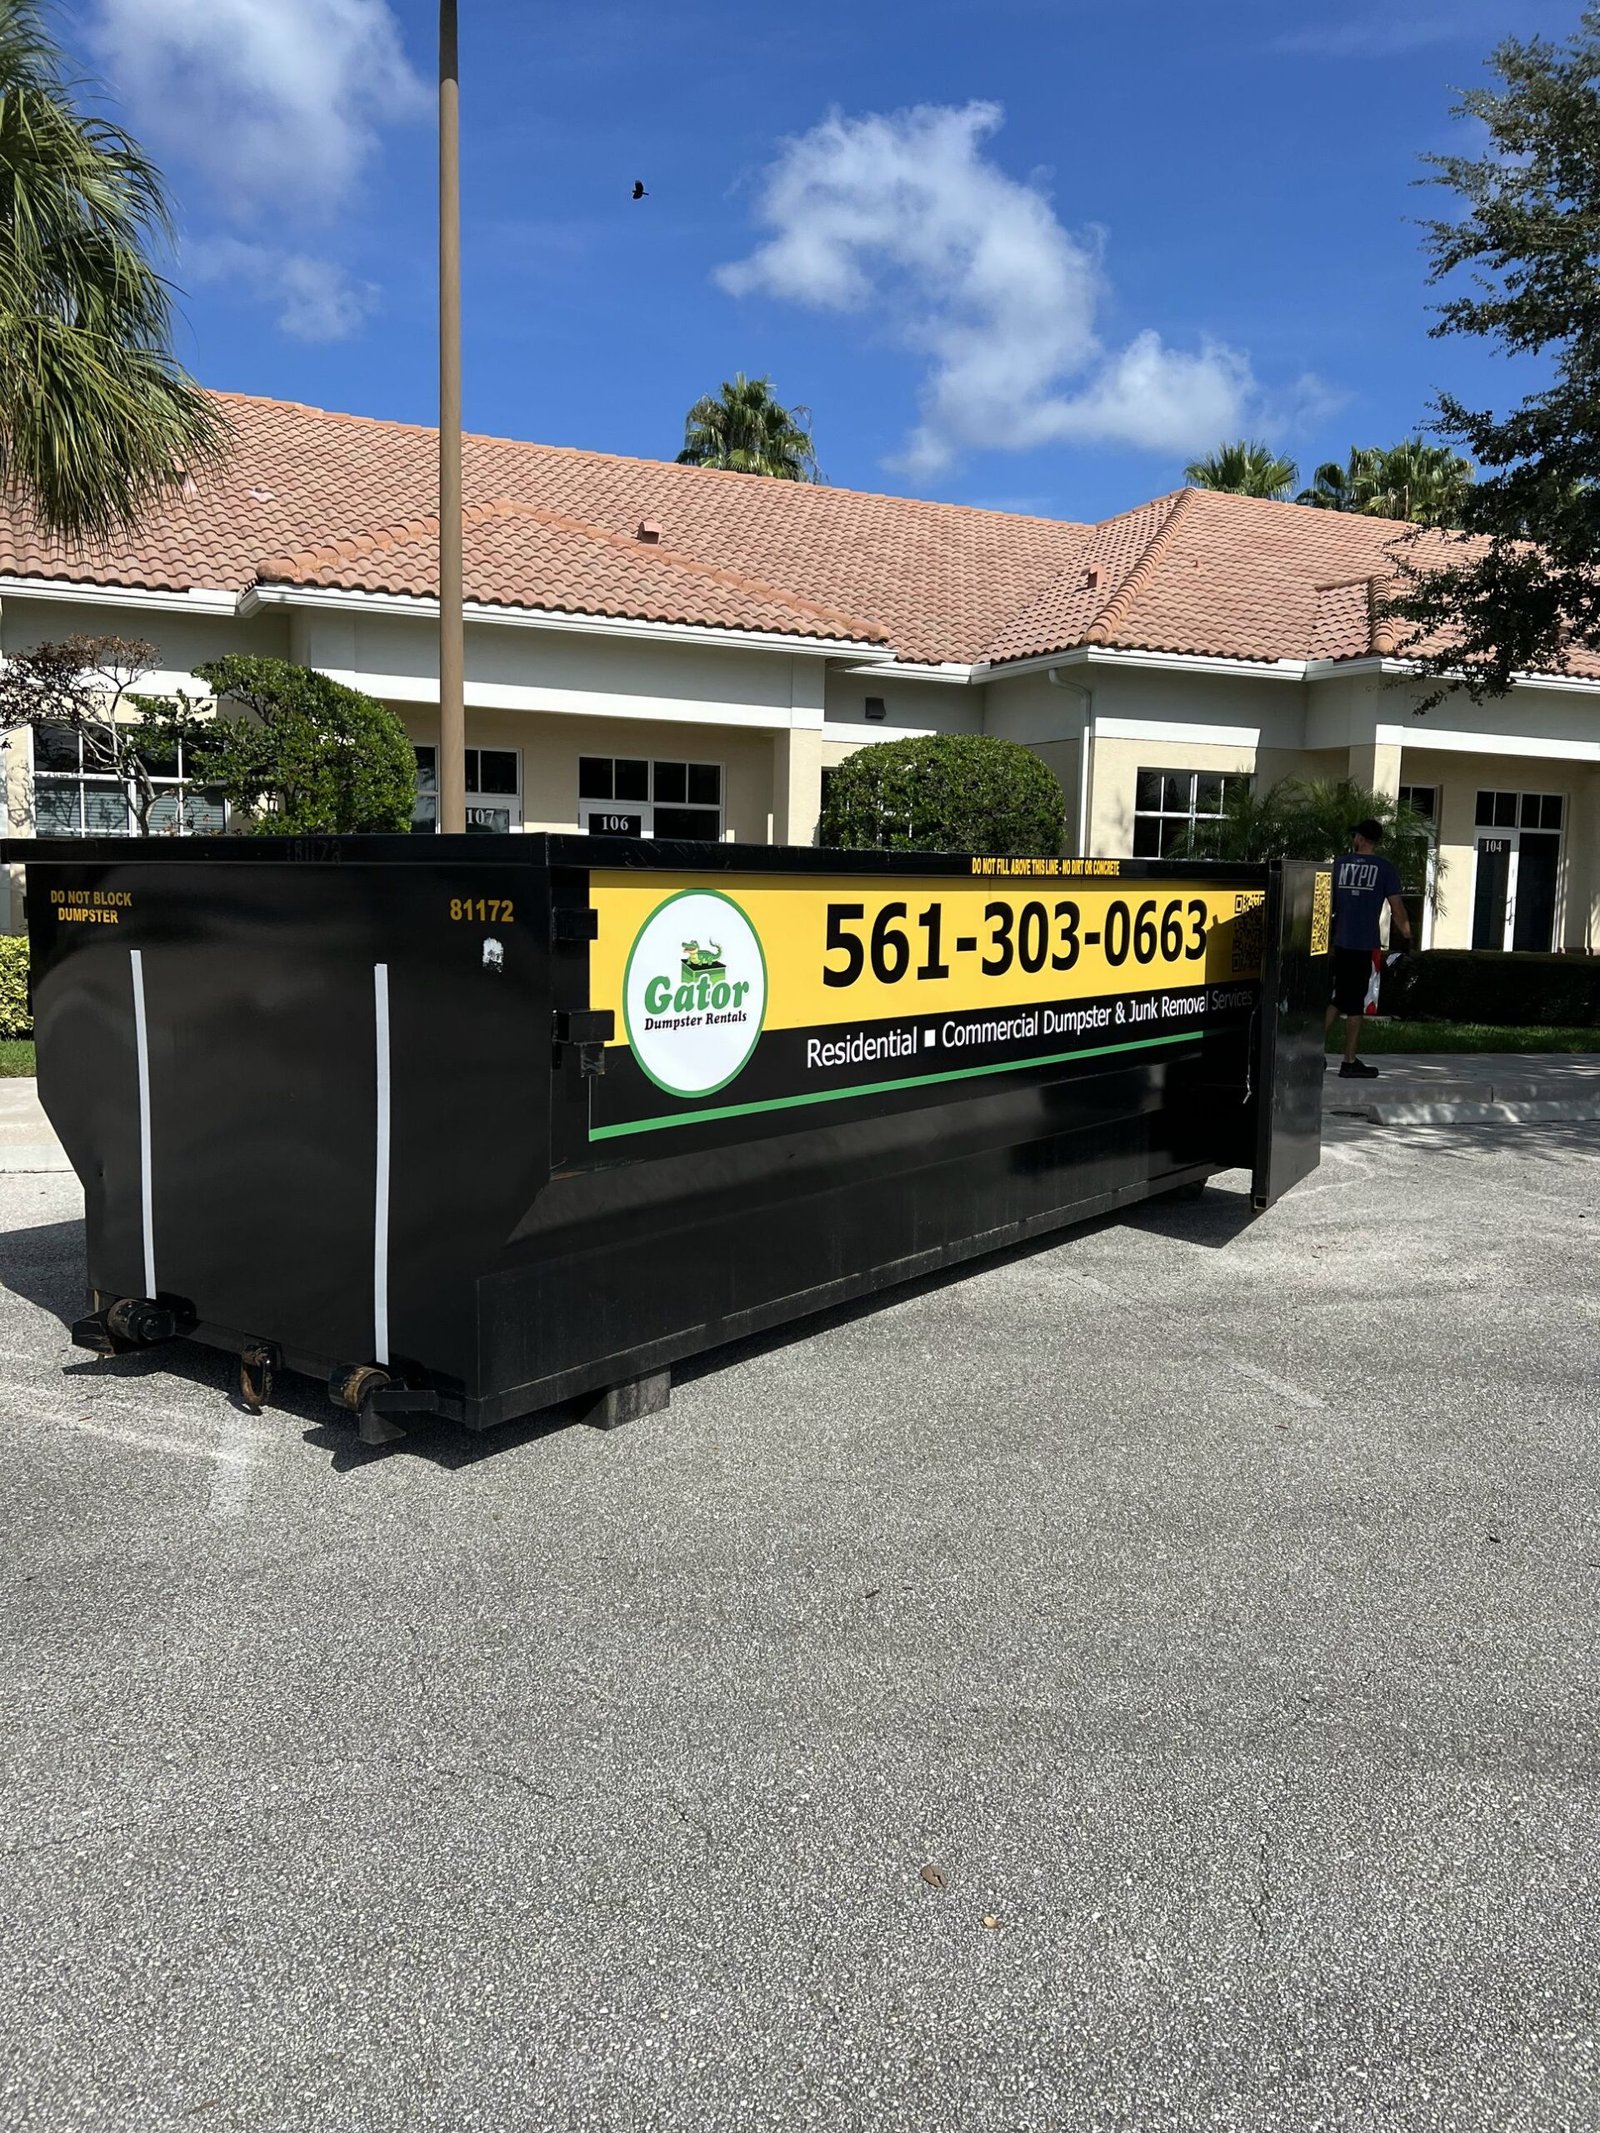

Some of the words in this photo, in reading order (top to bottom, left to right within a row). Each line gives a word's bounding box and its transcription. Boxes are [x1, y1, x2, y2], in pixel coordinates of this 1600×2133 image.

[466, 808, 495, 825] 107
[601, 815, 629, 831] 106
[1484, 840, 1503, 853] 104
[972, 857, 982, 874] DO
[982, 857, 996, 875] NOT
[996, 858, 1010, 875] FILL
[1011, 858, 1031, 875] ABOVE
[1031, 859, 1045, 875] THIS
[1045, 859, 1059, 875] LINE
[1062, 859, 1071, 876] NO
[1071, 859, 1085, 876] DIRT
[1085, 860, 1093, 876] OR
[1093, 860, 1120, 876] CONCRETE
[1338, 863, 1379, 888] NYPD
[50, 890, 66, 904] DO
[67, 890, 91, 905] NOT
[93, 891, 133, 907] BLOCK
[57, 908, 119, 924] DUMPSTER
[449, 898, 515, 923] 81172
[822, 898, 1208, 989] 561-303-0663
[643, 974, 750, 1016] Gator
[644, 1015, 703, 1031] Dumpster
[706, 1010, 748, 1026] Rentals
[806, 1027, 918, 1069] Residential
[942, 1009, 1038, 1049] Commercial
[1043, 1007, 1111, 1036] Dumpster
[1114, 1002, 1127, 1023] &
[1128, 996, 1159, 1021] Junk
[1161, 989, 1208, 1017] Removal
[1211, 988, 1253, 1011] Services
